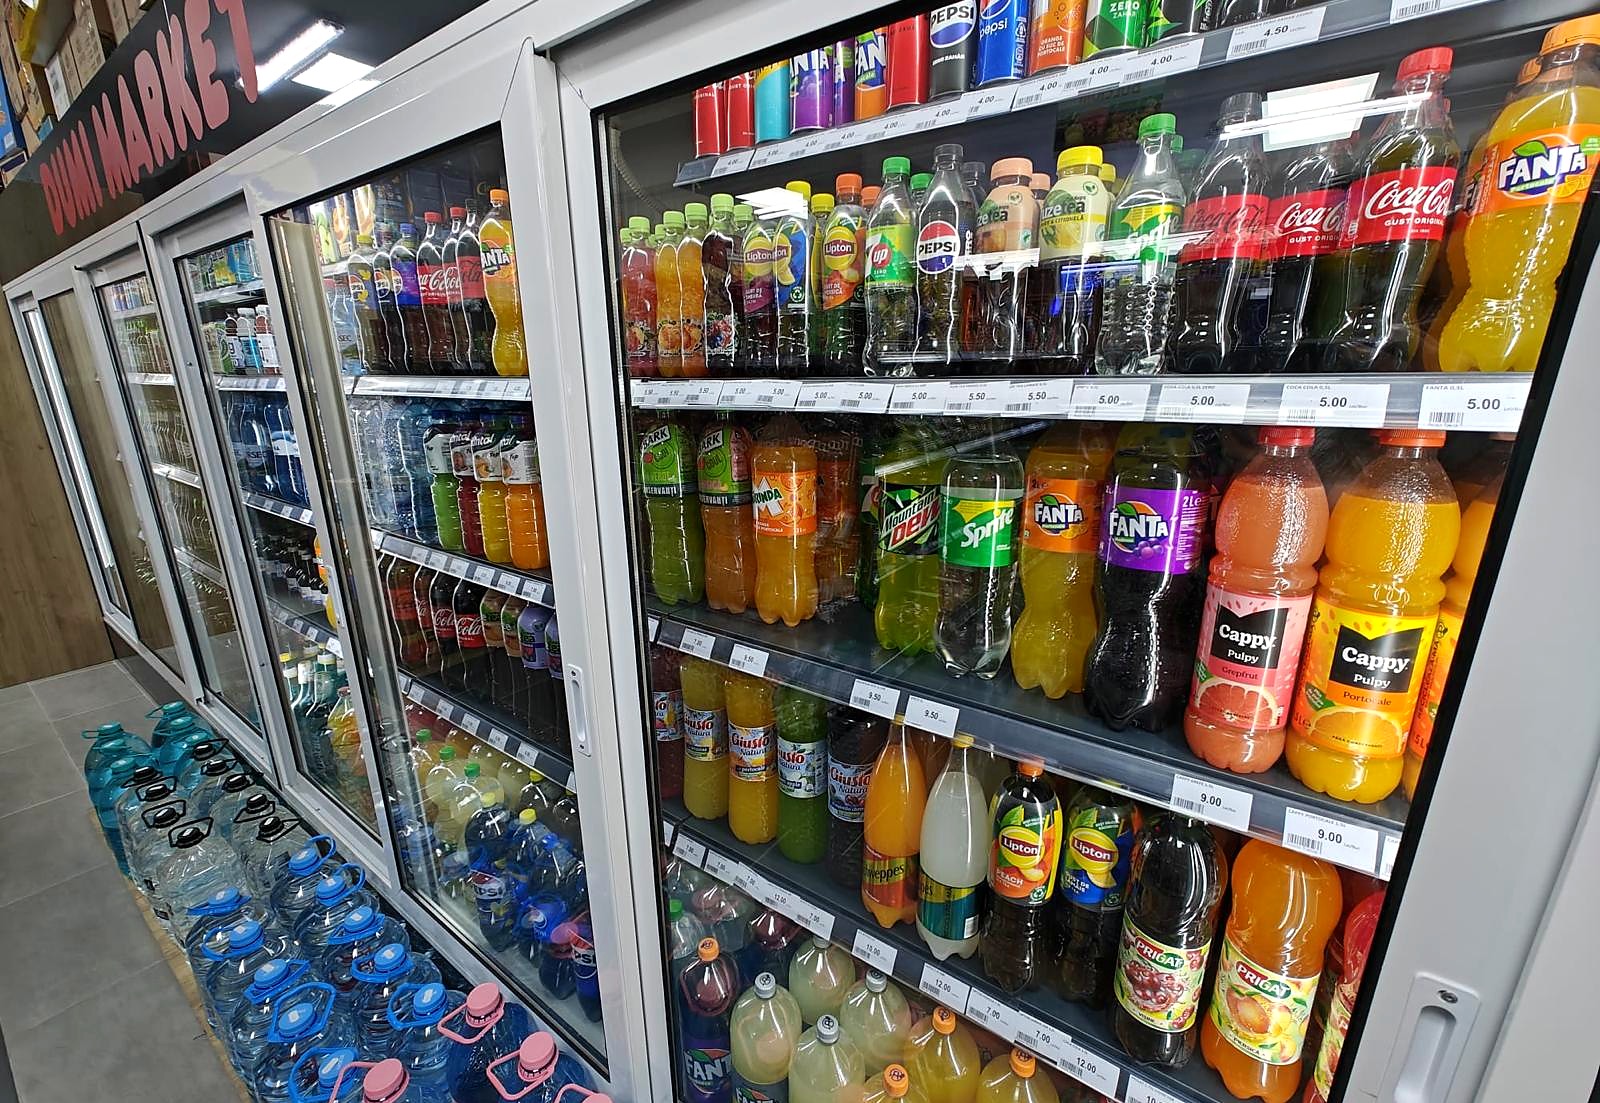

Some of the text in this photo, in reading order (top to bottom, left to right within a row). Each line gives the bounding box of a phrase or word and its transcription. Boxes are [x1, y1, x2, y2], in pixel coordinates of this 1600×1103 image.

[1109, 2, 1140, 12] ZERO
[930, 5, 975, 27] PEPSI
[980, 17, 1009, 41] pepsi
[1264, 25, 1289, 38] 4.50
[1151, 55, 1173, 66] 4.00
[1090, 66, 1109, 76] 4.00
[1040, 81, 1058, 92] 4.00
[979, 96, 996, 105] 4.00
[40, 0, 258, 236] DUMI MARKET
[936, 110, 951, 119] 4.00
[884, 122, 899, 131] 4.00
[1498, 144, 1588, 191] FANTA
[1384, 216, 1414, 227] GUST
[1289, 236, 1313, 244] GUST
[746, 248, 772, 263] Lipton
[825, 243, 852, 256] Lipton
[918, 241, 956, 256] PEPSI
[771, 387, 785, 396] 5.00
[814, 391, 828, 400] 5.00
[858, 391, 873, 400] 5.00
[911, 391, 928, 401] 5.00
[968, 391, 986, 401] 5.50
[1027, 391, 1047, 401] 5.50
[1098, 394, 1120, 405] 5.00
[1190, 395, 1215, 406] 5.00
[1319, 396, 1347, 408] 5.00
[1466, 398, 1501, 411] 5.00
[884, 490, 937, 534] Mountain
[1034, 502, 1084, 525] FANTA
[959, 507, 1014, 549] Sprite
[1109, 508, 1169, 538] FANTA
[1218, 623, 1276, 653] Cappy
[1227, 648, 1260, 664] Pulpy
[1341, 645, 1409, 674] Cappy
[1221, 666, 1258, 679] Grepfrut
[1353, 673, 1391, 689] Pulpy
[868, 691, 882, 702] 9.50
[924, 709, 939, 720] 9.50
[731, 732, 770, 749] Giusto
[831, 766, 871, 788] Giusto
[1200, 792, 1223, 808] 9.00
[1318, 828, 1343, 844] 9.00
[1003, 836, 1038, 855] Lipton
[1073, 839, 1112, 861] Lipton
[1137, 941, 1184, 968] PRIGAT
[934, 979, 952, 994] 12.00
[1237, 964, 1291, 998] PRIGAT
[986, 1005, 1001, 1020] 7.00
[1035, 1029, 1051, 1045] 7.00
[1076, 1056, 1097, 1075] 12.00
